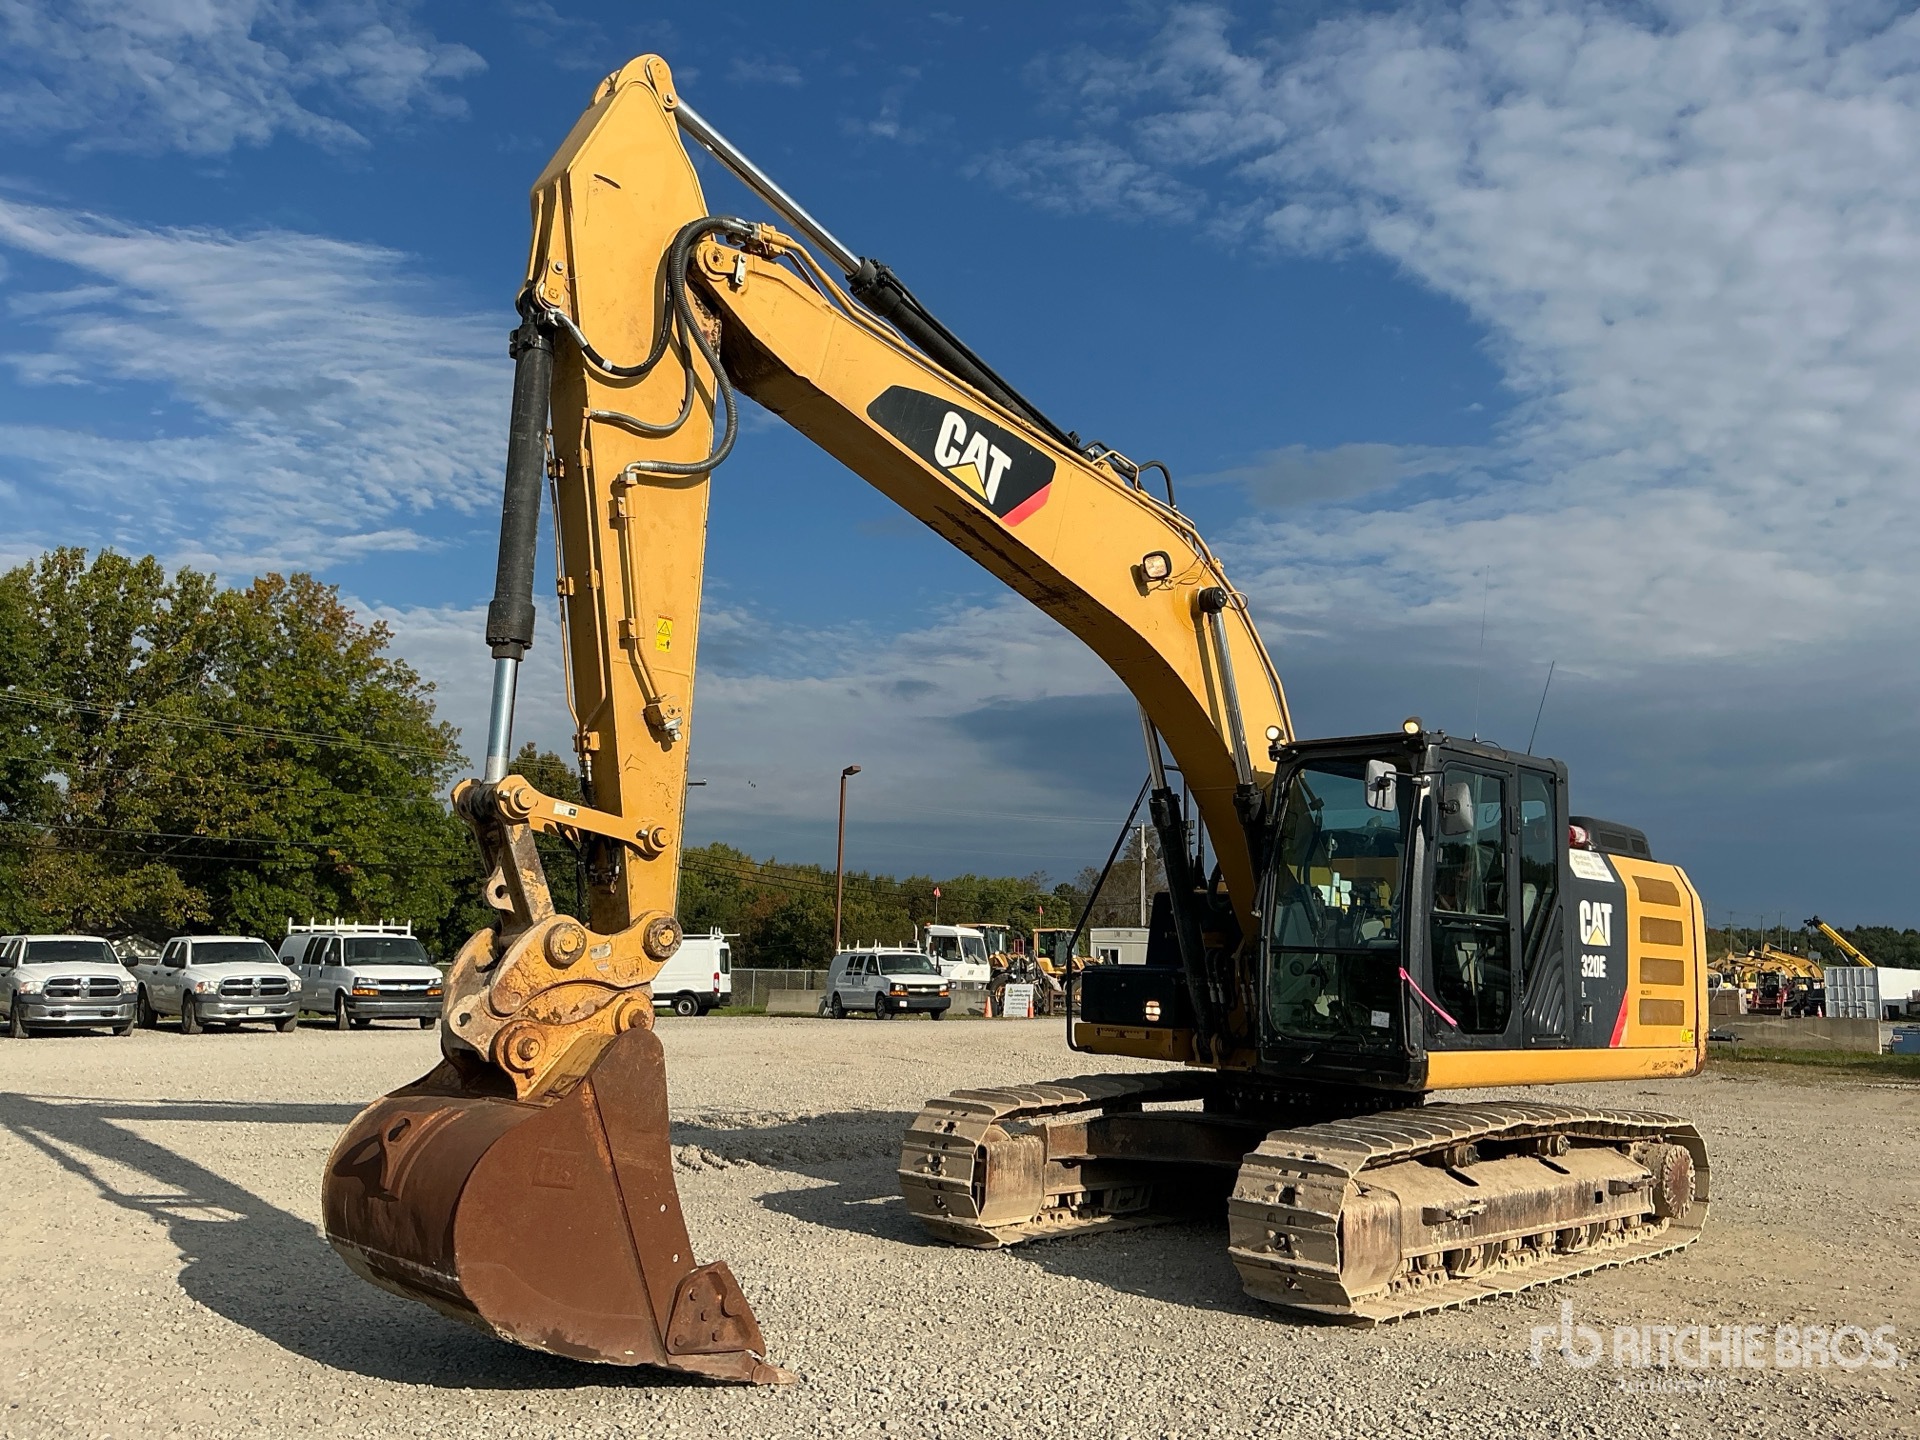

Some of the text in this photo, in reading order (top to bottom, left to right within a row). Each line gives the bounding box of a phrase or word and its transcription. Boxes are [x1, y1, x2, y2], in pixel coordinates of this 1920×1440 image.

[934, 411, 1012, 505] CAT
[1579, 899, 1612, 946] CAT
[1581, 954, 1607, 978] 320E
